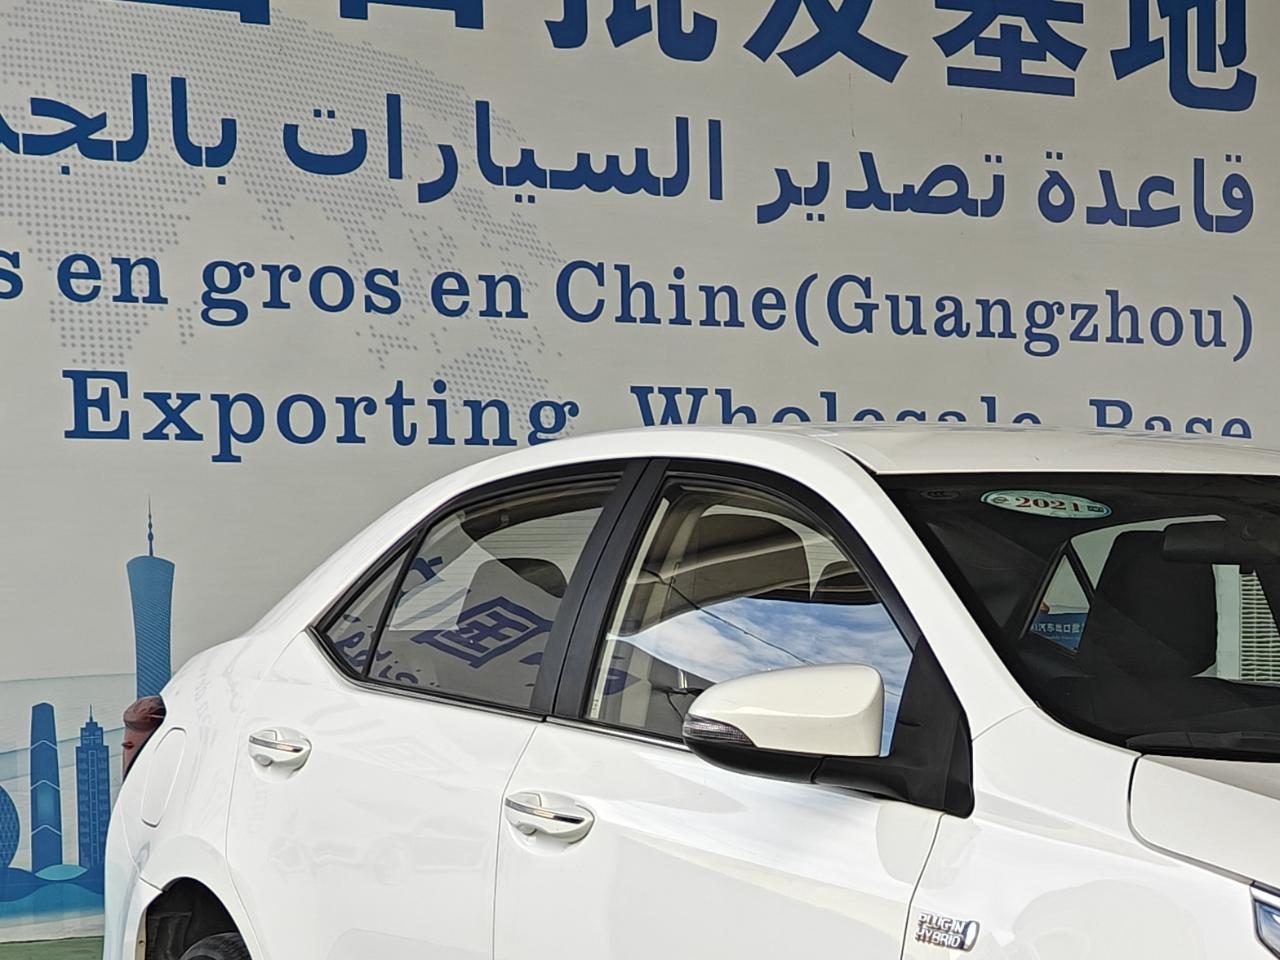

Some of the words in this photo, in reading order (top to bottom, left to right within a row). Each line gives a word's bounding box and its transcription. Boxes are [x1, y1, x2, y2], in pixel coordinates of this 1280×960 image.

[282, 92, 723, 204] السيارات
[756, 151, 1006, 225] تصدير
[1036, 151, 1255, 234] قاعدة
[56, 252, 168, 306] en
[200, 259, 402, 328] gros
[430, 270, 529, 320] en
[555, 260, 1253, 363] Chine(Guangzhou)
[62, 369, 580, 463] Exporting
[1015, 496, 1081, 512] 2021
